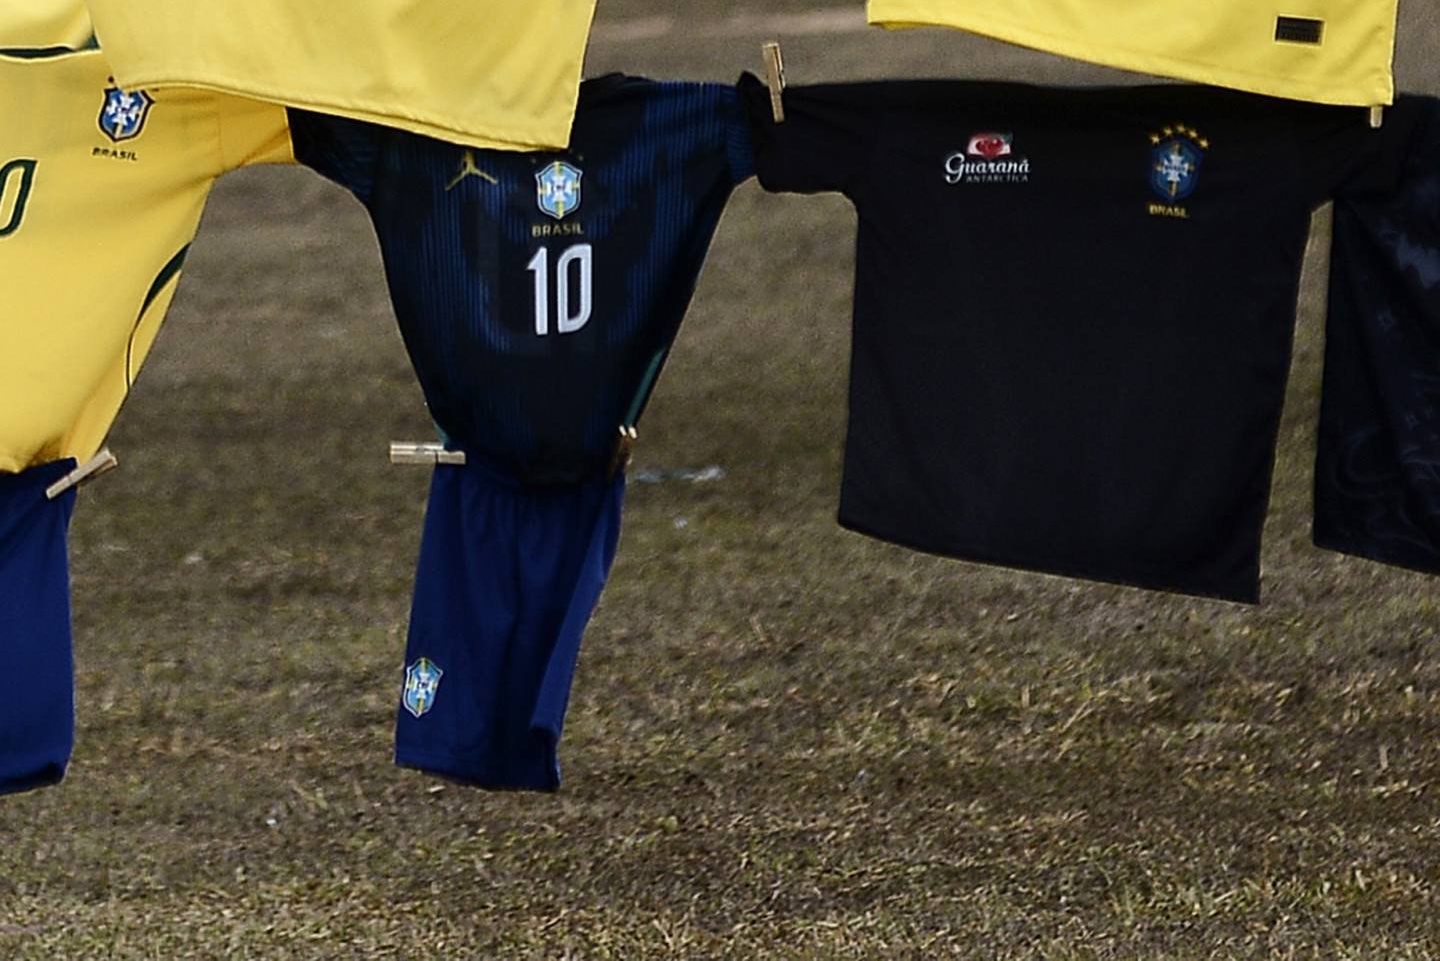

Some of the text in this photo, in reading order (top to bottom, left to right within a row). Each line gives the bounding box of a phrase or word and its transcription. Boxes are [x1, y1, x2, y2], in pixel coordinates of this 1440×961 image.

[92, 147, 137, 161] BRASIL
[944, 152, 1030, 184] Guaraná
[1148, 203, 1190, 218] BRASIL
[531, 223, 585, 238] BRASIL
[526, 243, 593, 336] 10
